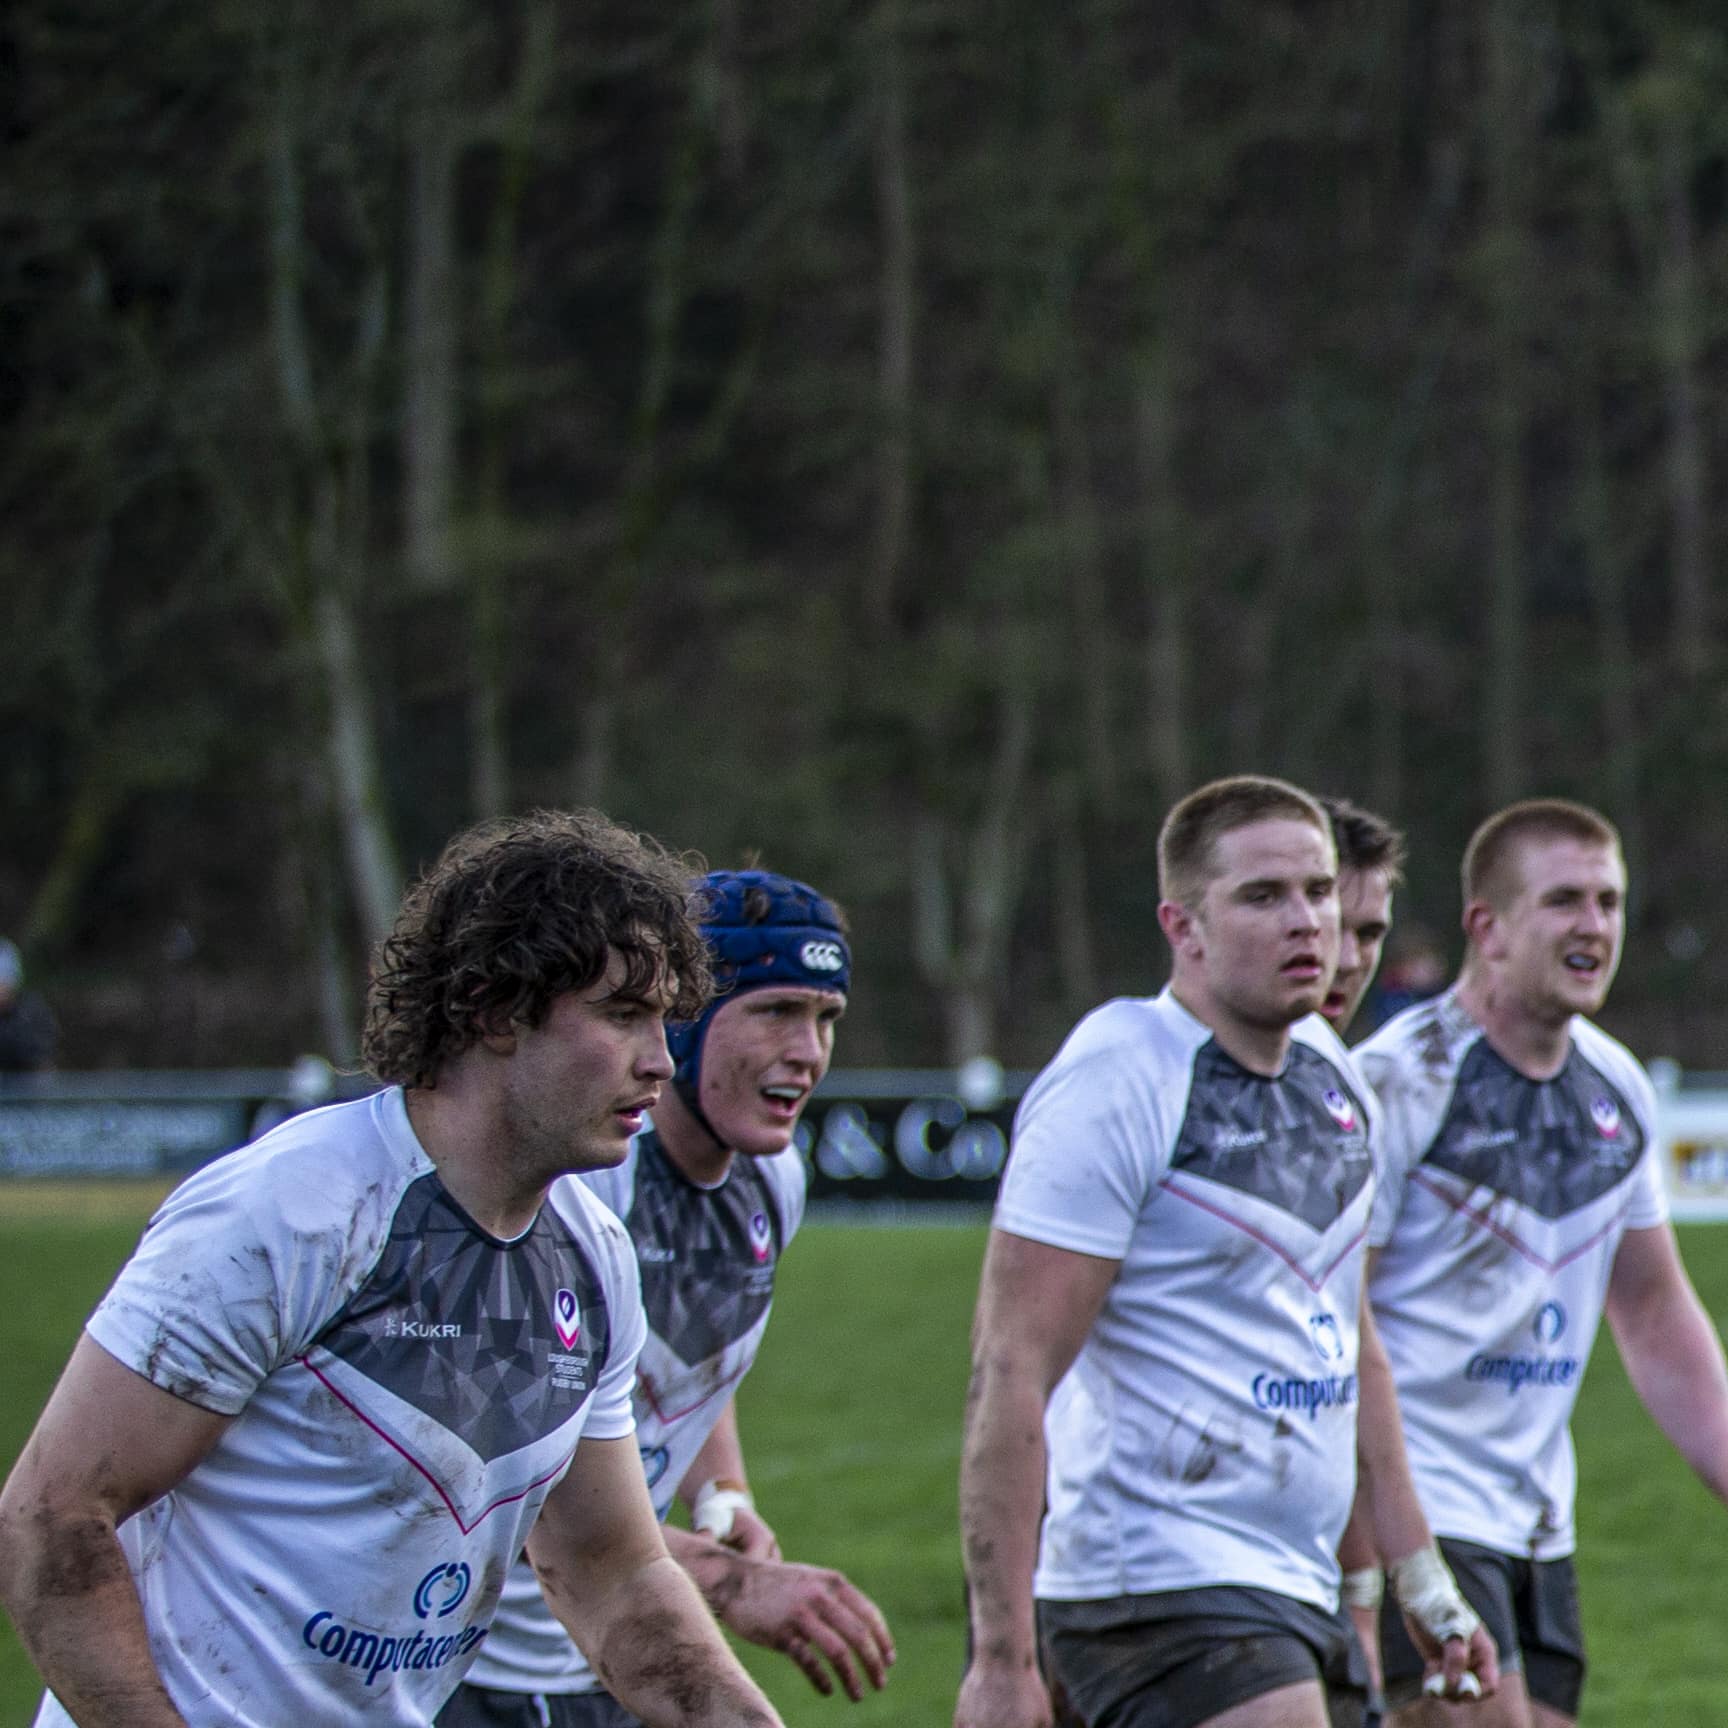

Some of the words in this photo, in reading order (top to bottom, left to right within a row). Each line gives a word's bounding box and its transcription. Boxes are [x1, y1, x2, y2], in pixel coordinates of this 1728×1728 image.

[816, 1103, 888, 1180] &
[401, 1321, 461, 1338] KUKRI
[1252, 1373, 1356, 1420] Computa
